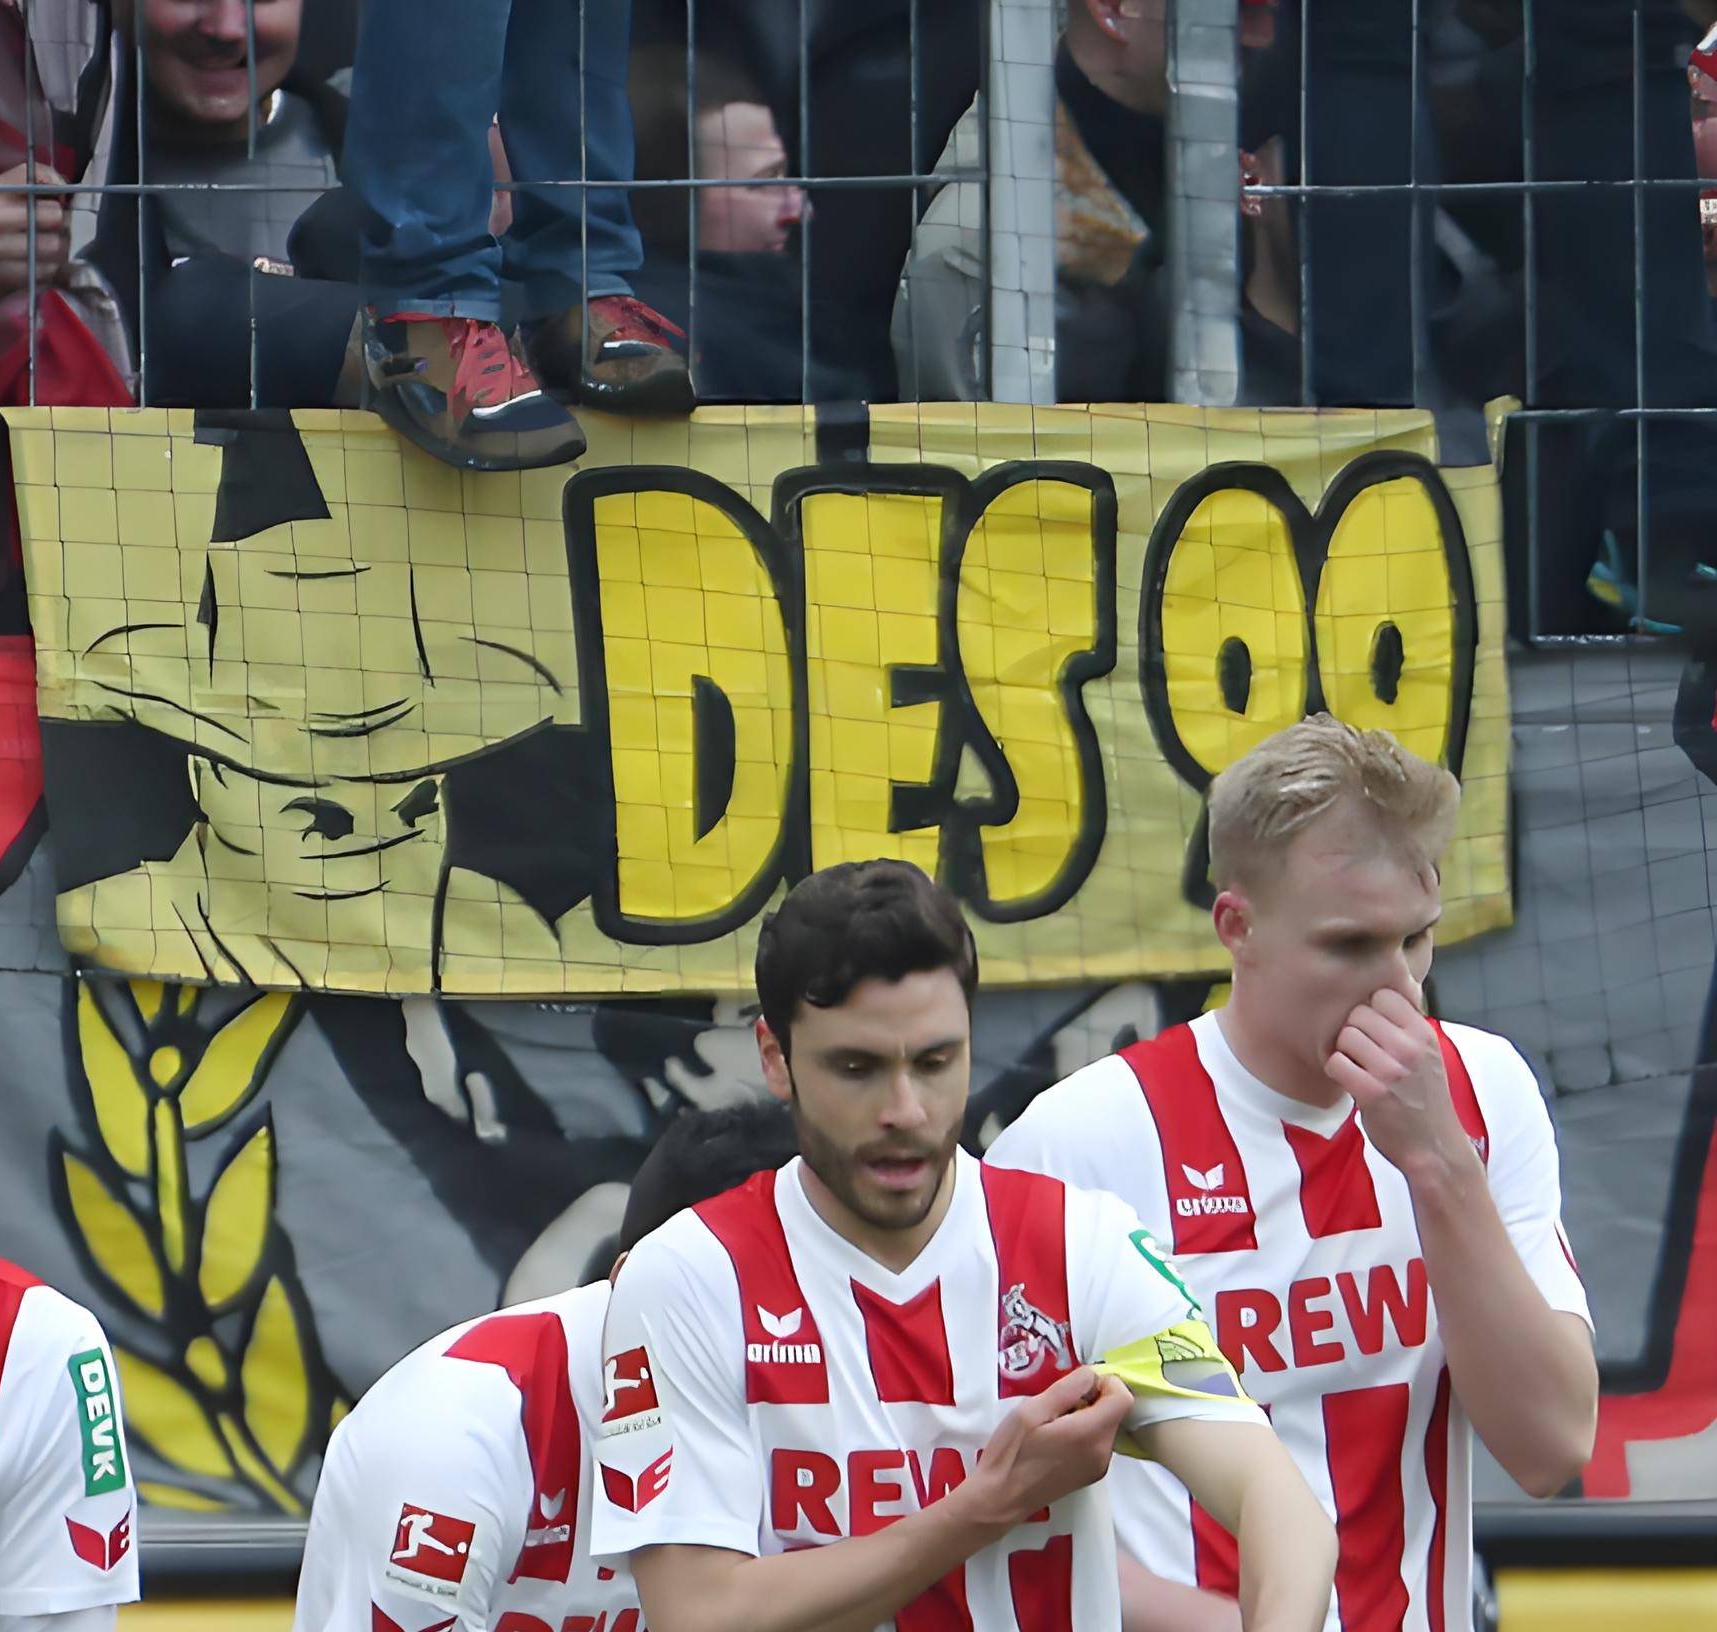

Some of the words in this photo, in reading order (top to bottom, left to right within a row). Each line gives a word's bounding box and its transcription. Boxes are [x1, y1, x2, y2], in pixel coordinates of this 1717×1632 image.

[563, 460, 1118, 946] DES
[1216, 1257, 1431, 1373] REW
[79, 1358, 117, 1482] DEVK
[771, 1447, 1051, 1537] REW
